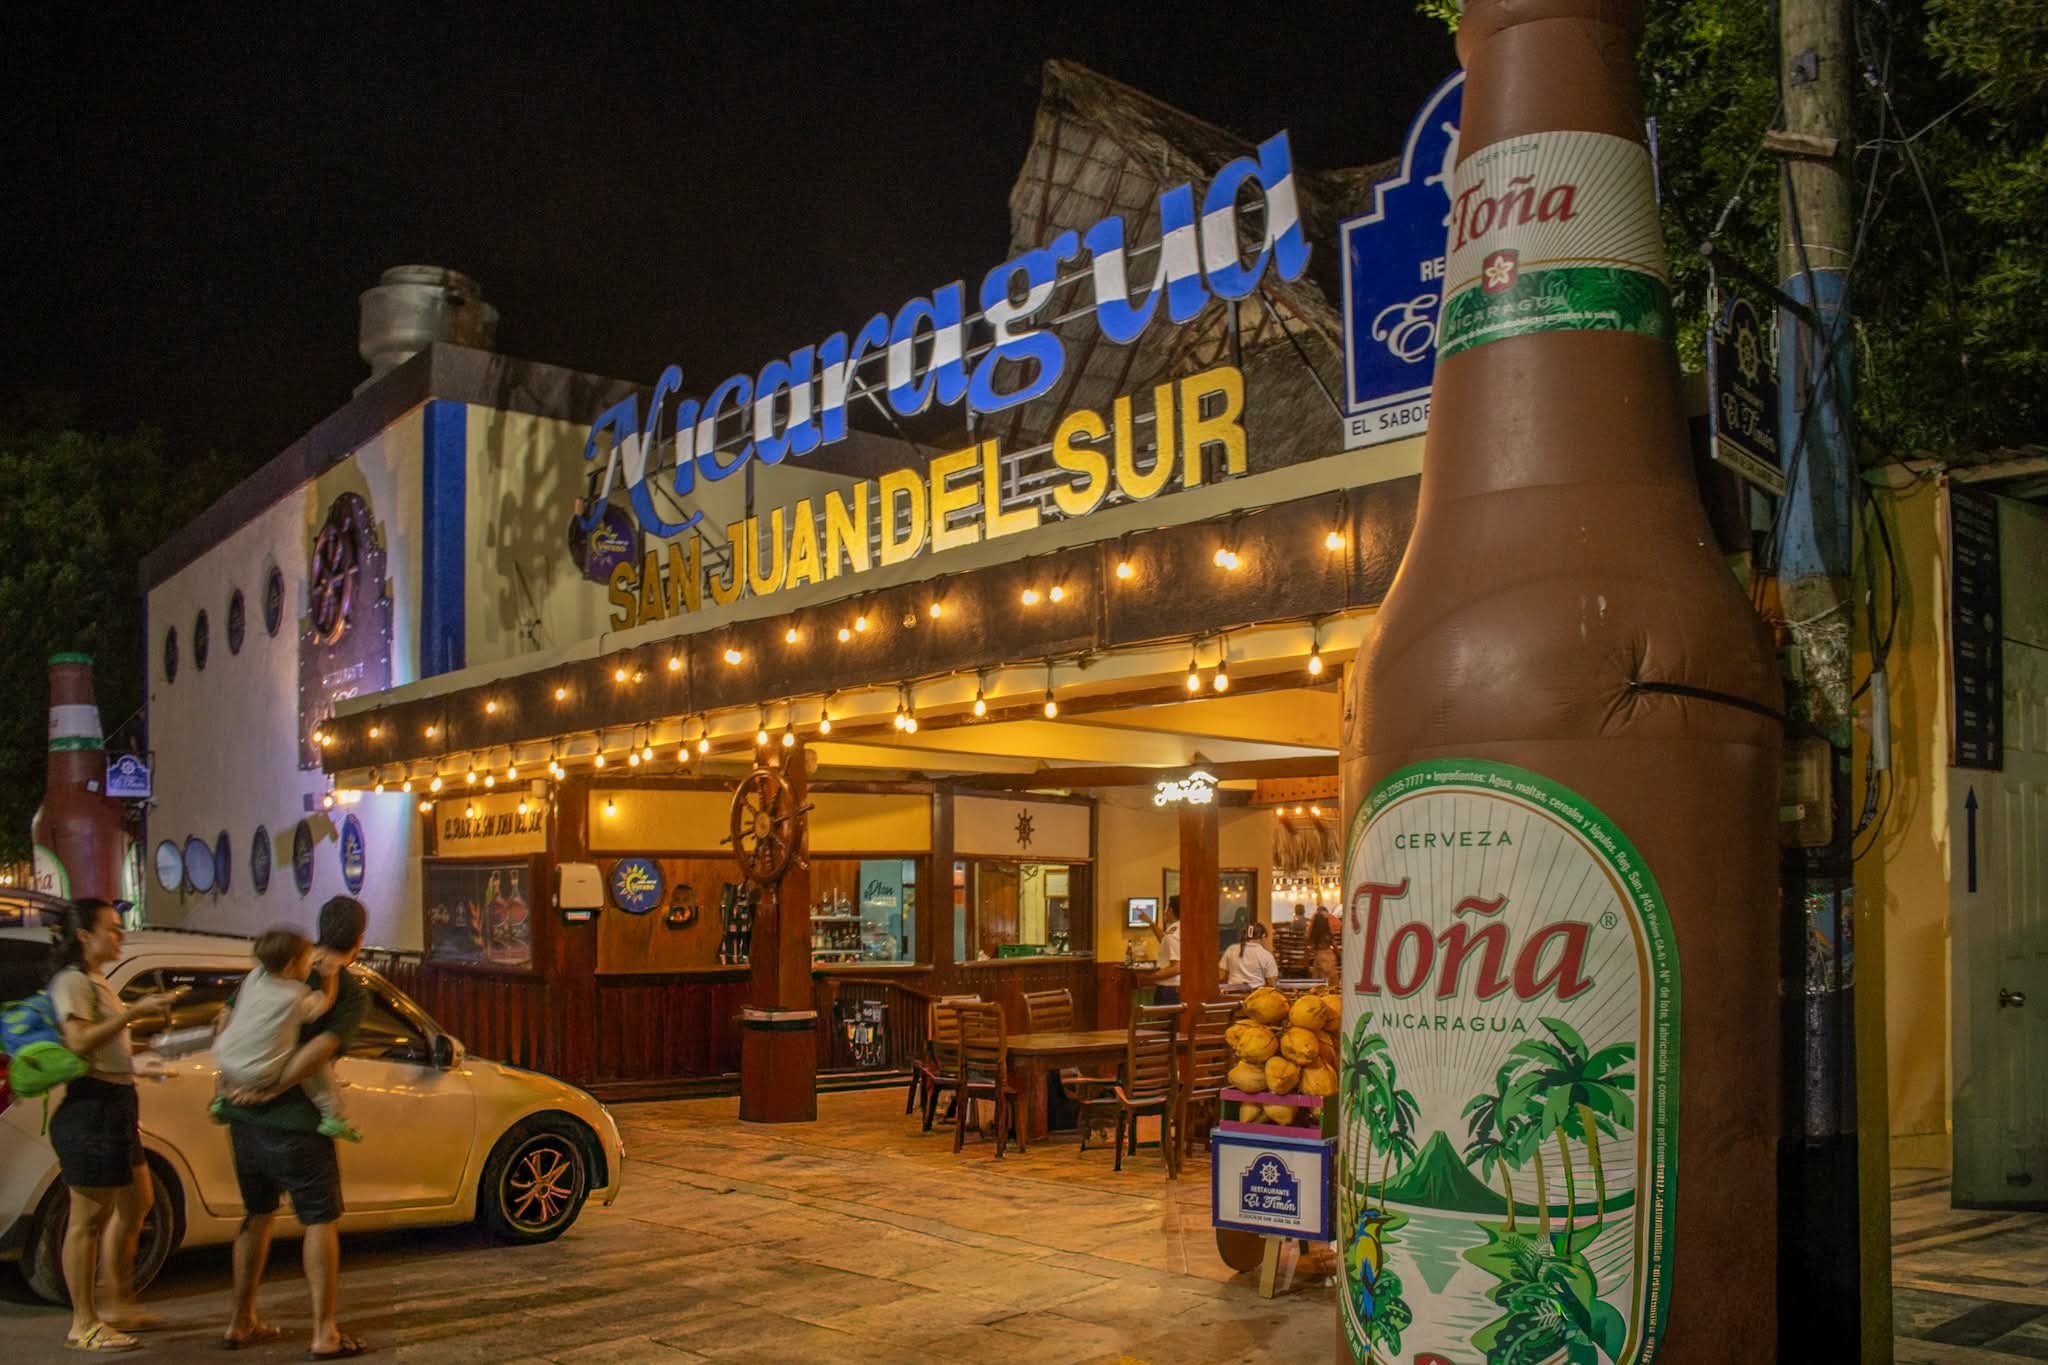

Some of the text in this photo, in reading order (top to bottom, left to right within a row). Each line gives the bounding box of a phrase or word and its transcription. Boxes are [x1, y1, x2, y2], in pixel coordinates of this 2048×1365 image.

[1476, 143, 1539, 168] CERVEZA
[1452, 173, 1578, 254] Toña
[576, 128, 1313, 539] Nicaragua
[1351, 419, 1372, 437] EL
[608, 365, 1248, 632] SAN JUAN DEL SUR
[1488, 773, 1513, 790] Agua,
[1515, 782, 1547, 804] maltas,
[1549, 797, 1584, 824] cereales
[1582, 818, 1592, 830] y
[1394, 830, 1513, 850] CERVEZA
[1351, 876, 1597, 1004] Toña
[1381, 1012, 1528, 1034] NICARAGUA
[1243, 1193, 1297, 1212] El Timón
